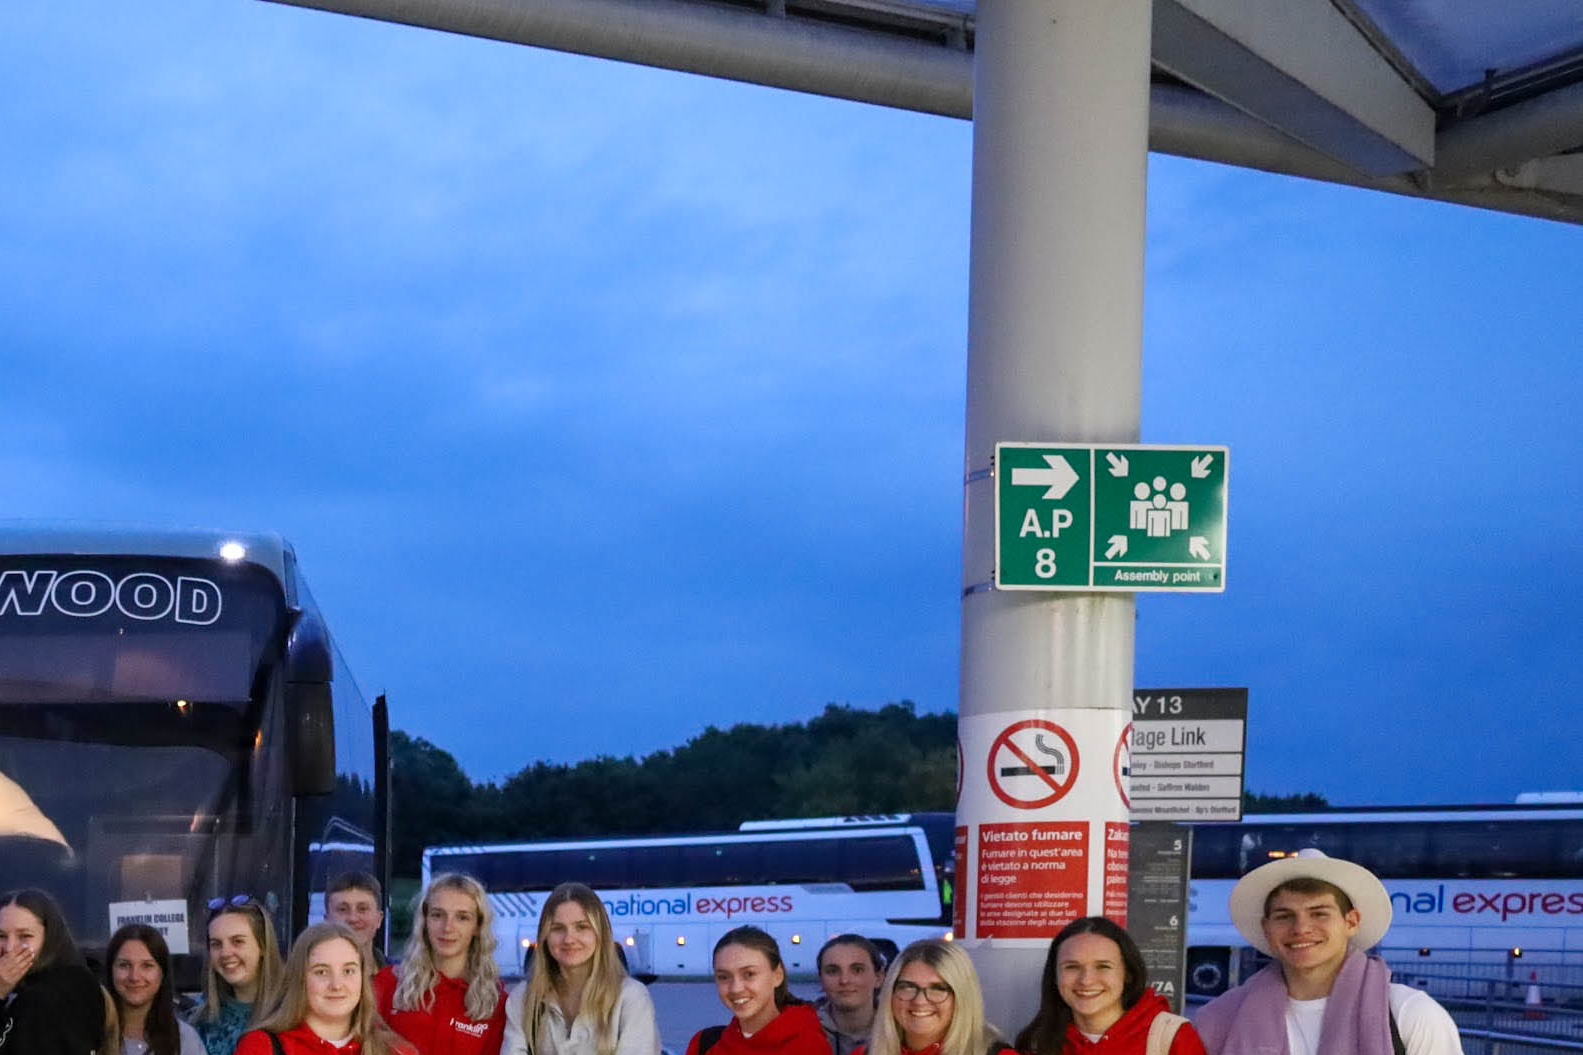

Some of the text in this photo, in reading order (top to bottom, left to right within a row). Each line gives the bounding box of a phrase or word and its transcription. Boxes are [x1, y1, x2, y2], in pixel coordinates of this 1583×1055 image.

[1019, 509, 1073, 538] A.P
[1034, 548, 1057, 578] 8
[1114, 569, 1201, 584] Assembly point
[1156, 696, 1183, 714] 13
[1131, 726, 1206, 750] lage Link
[982, 829, 1083, 842] Vietato fumare
[1173, 839, 1182, 851] 5
[982, 847, 1083, 859] Fumare in quest'area
[988, 861, 1021, 871] vietato
[1022, 862, 1029, 870] a
[1031, 861, 1066, 870] norma
[981, 874, 1017, 886] di legge
[602, 893, 793, 920] national express
[153, 913, 185, 924] COLLEGE
[1170, 915, 1179, 927] 6
